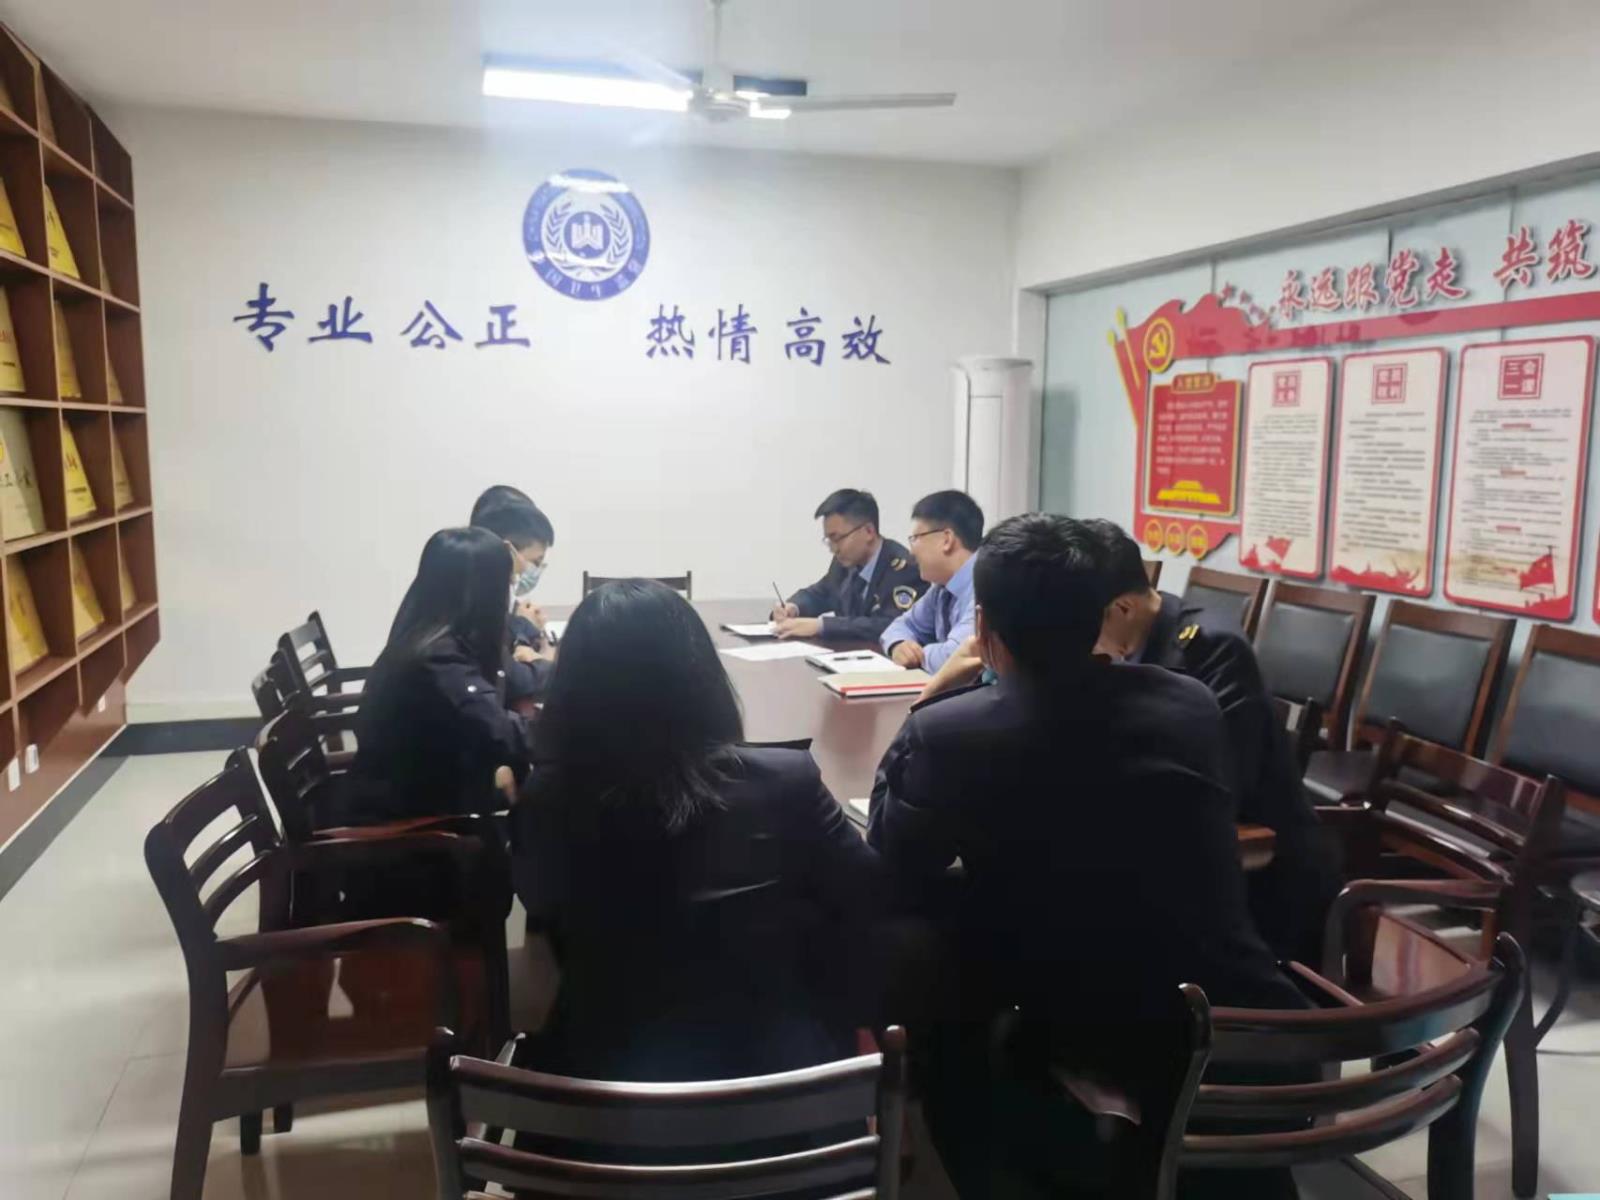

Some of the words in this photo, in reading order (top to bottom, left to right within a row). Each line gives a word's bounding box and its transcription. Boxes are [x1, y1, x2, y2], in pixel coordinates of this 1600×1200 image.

[1278, 247, 1468, 320] 永远跟党走
[1493, 219, 1597, 289] 共筑
[233, 282, 531, 352] 专业公正
[646, 303, 891, 367] 热情高效
